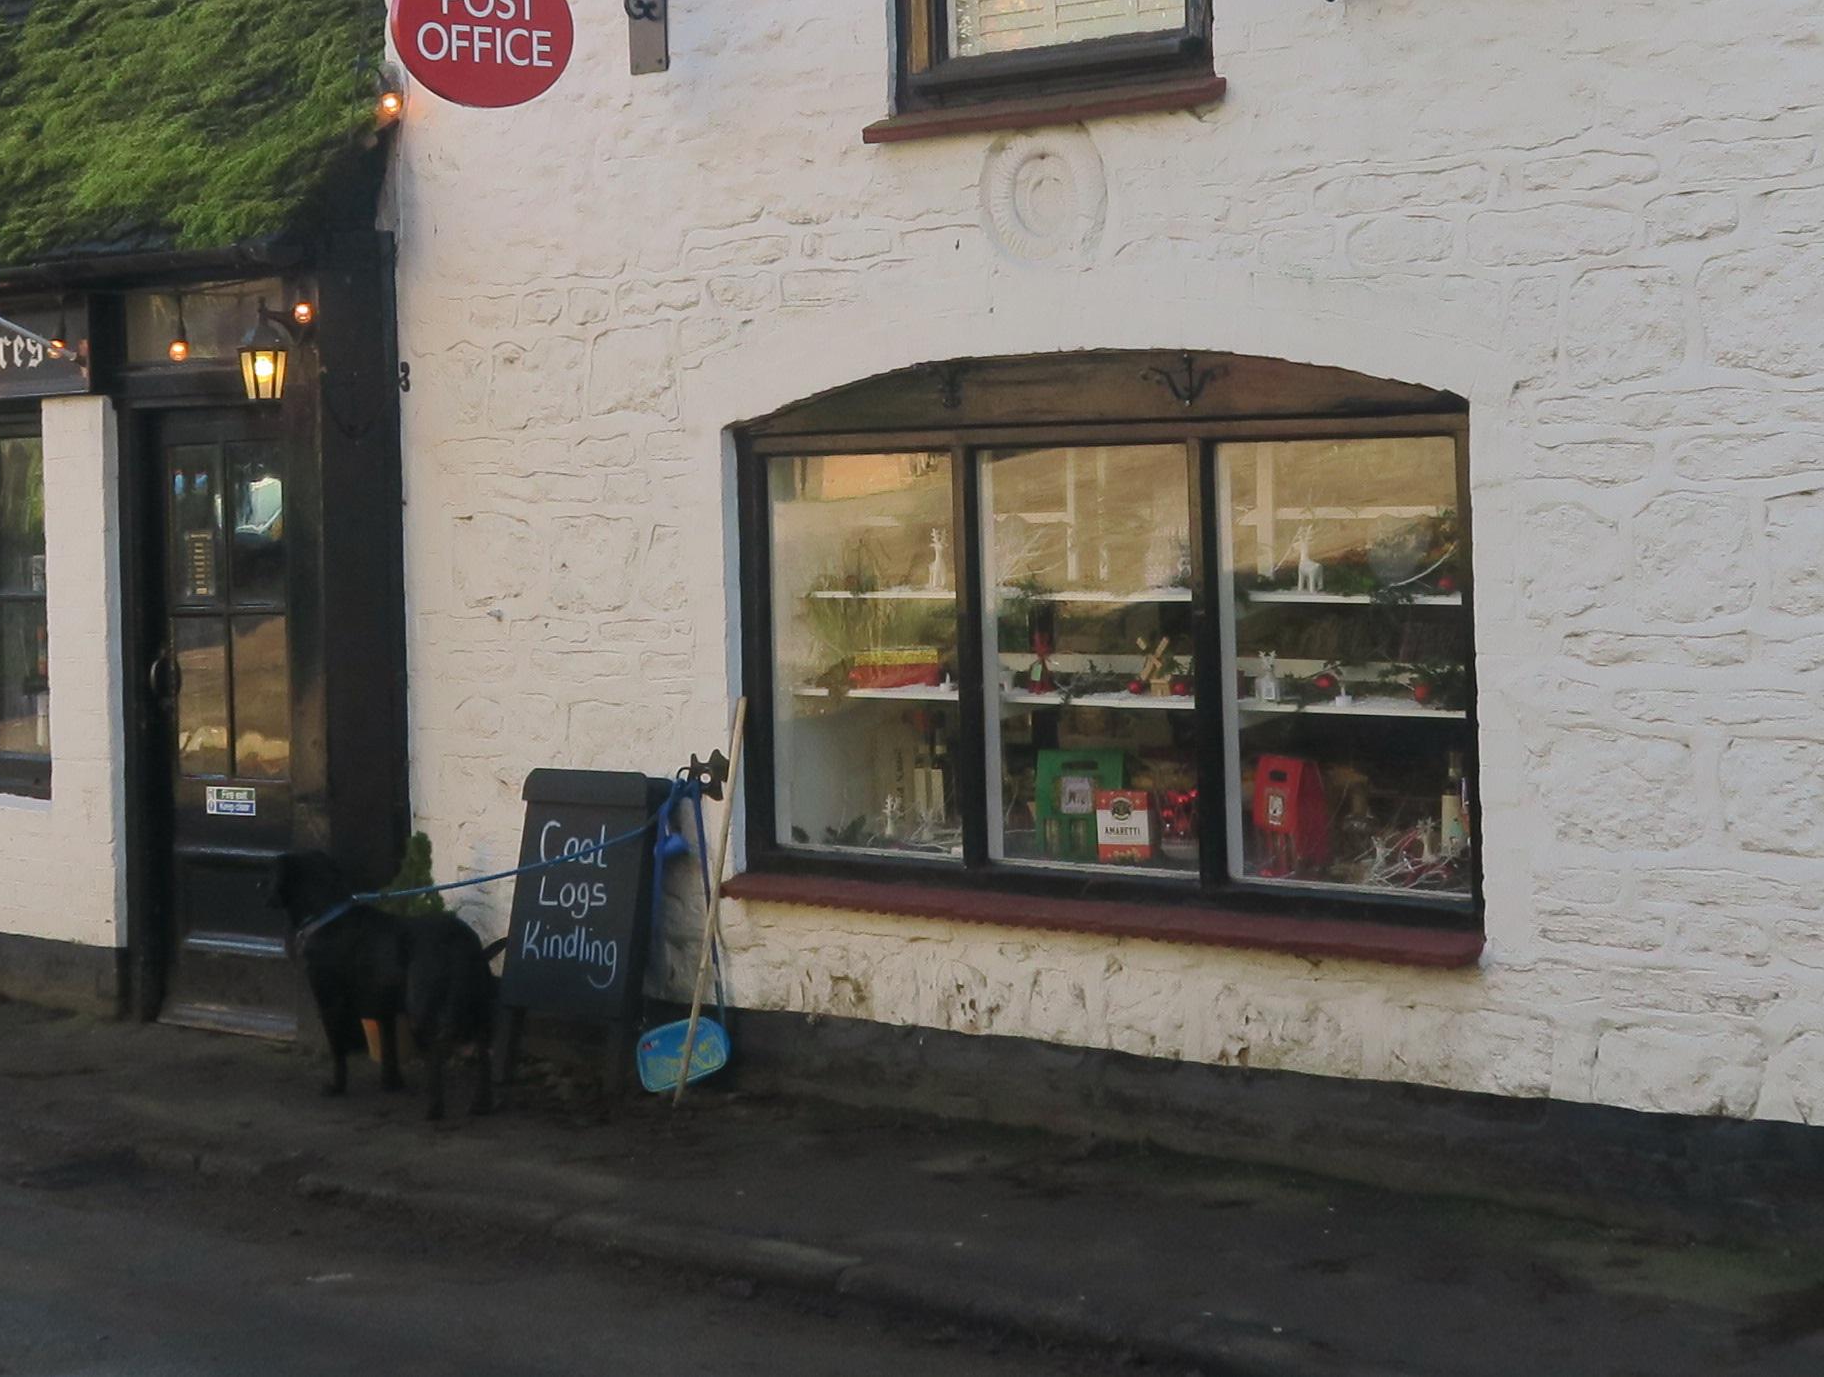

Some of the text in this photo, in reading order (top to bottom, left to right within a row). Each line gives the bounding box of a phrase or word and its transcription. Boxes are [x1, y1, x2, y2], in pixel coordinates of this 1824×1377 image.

[416, 21, 554, 67] OFFICE
[539, 820, 608, 868] Coal
[1105, 826, 1140, 835] AMARETTI
[538, 875, 608, 919] Logs
[521, 919, 618, 990] Kindling
